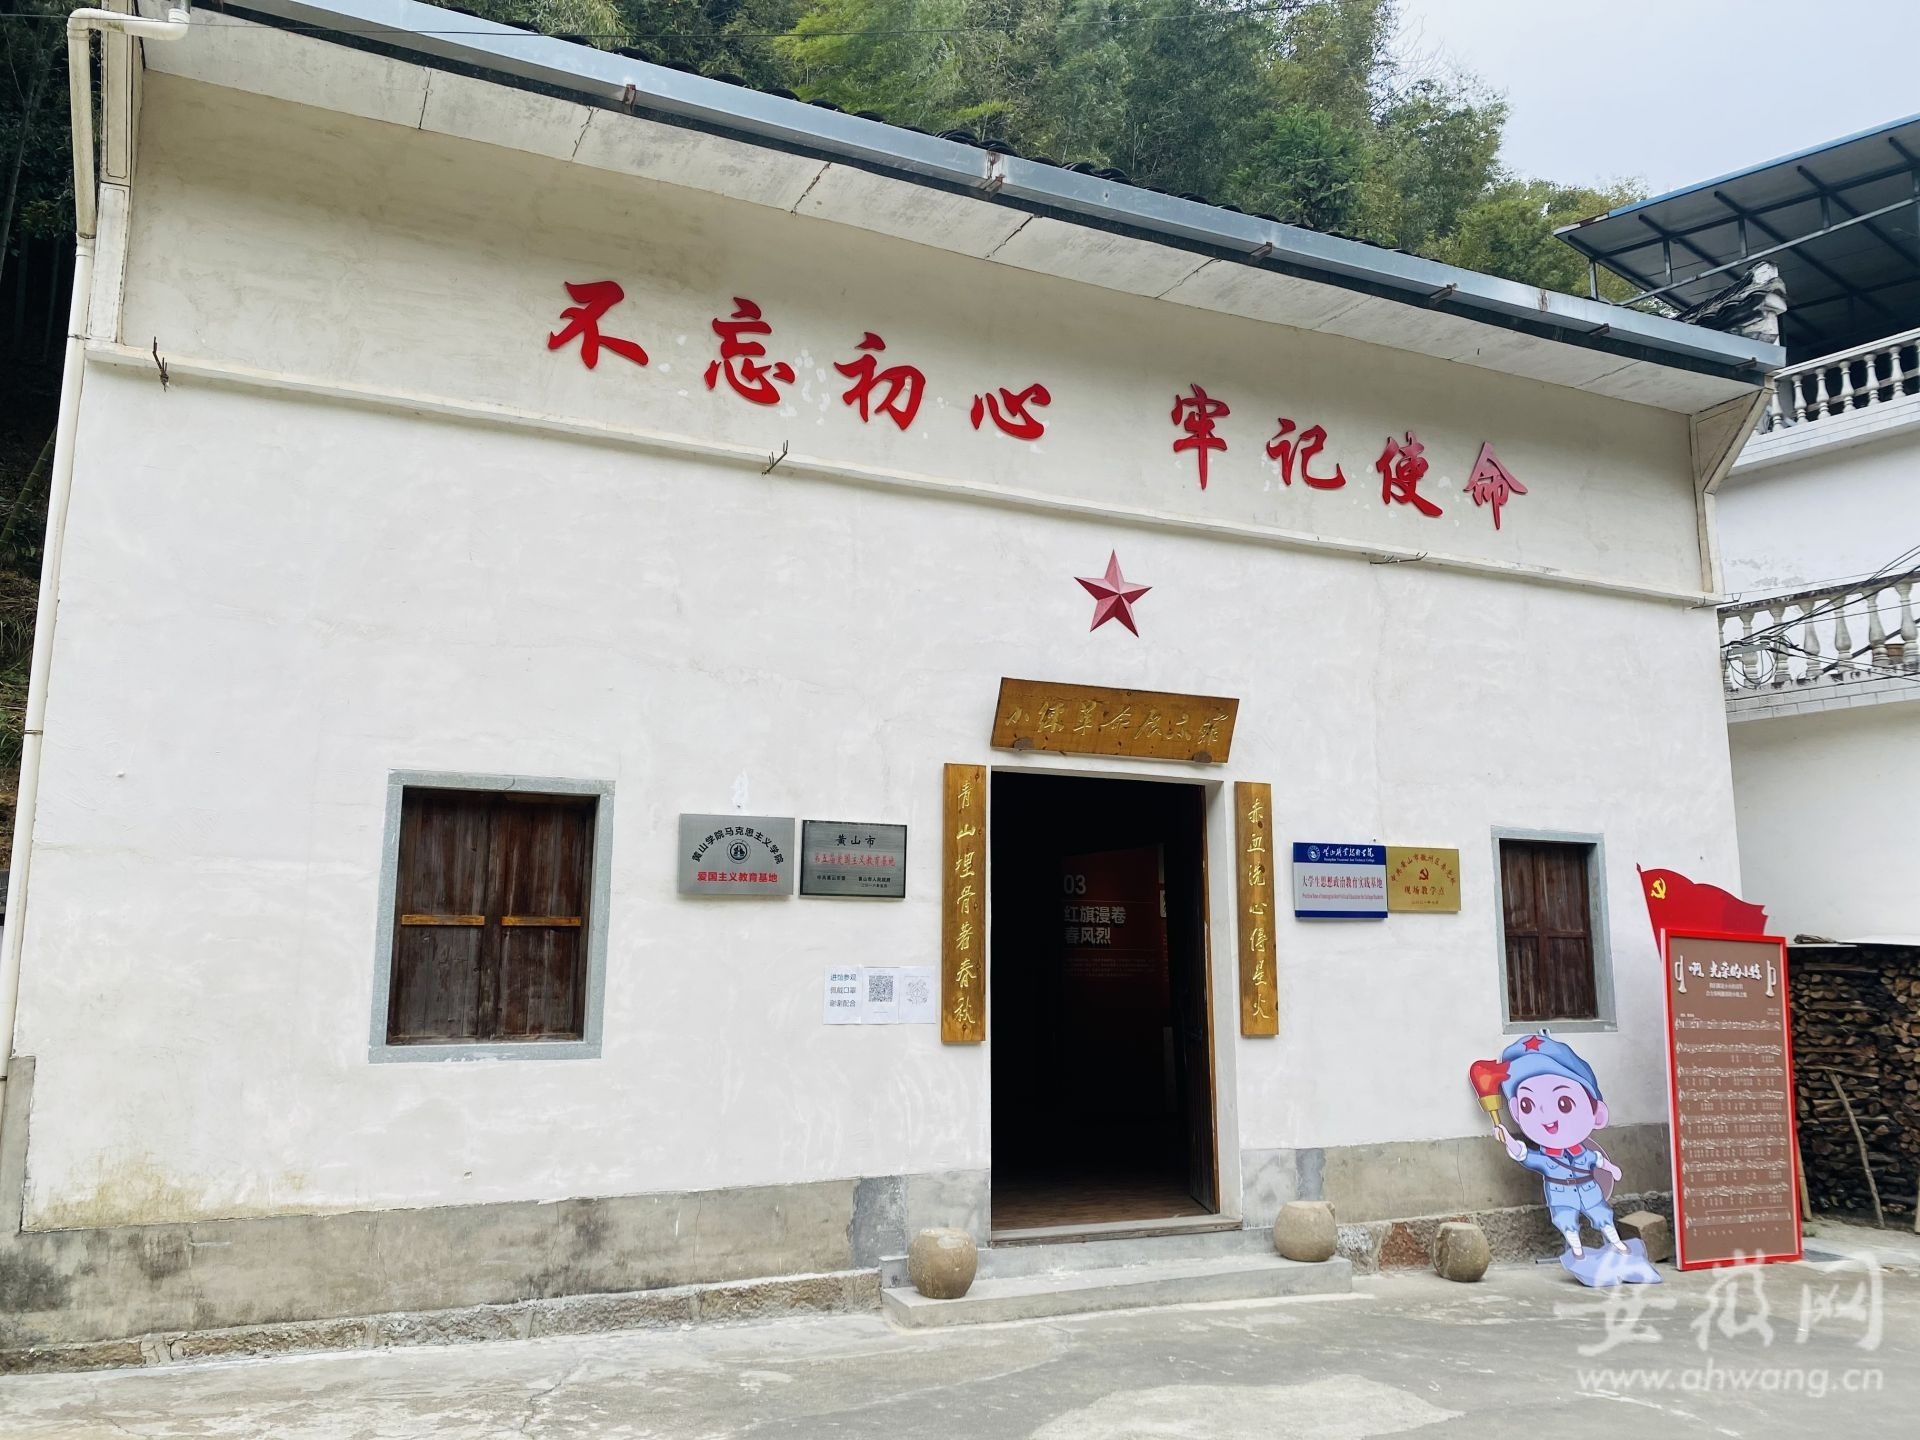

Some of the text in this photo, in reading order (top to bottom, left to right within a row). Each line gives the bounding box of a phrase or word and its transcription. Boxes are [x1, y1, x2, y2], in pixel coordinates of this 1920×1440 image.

[548, 280, 1529, 531] 不忘初心 牢记使命
[691, 826, 784, 865] 黄山学院马克思主义学院
[835, 834, 877, 848] 黄山市
[697, 871, 778, 883] 爱国主义教育基地
[1064, 874, 1086, 895] 03
[1302, 875, 1383, 889] 大学生思想政治教育实践基地
[1064, 905, 1126, 924] 红旗漫卷
[1064, 926, 1112, 945] 春风烈
